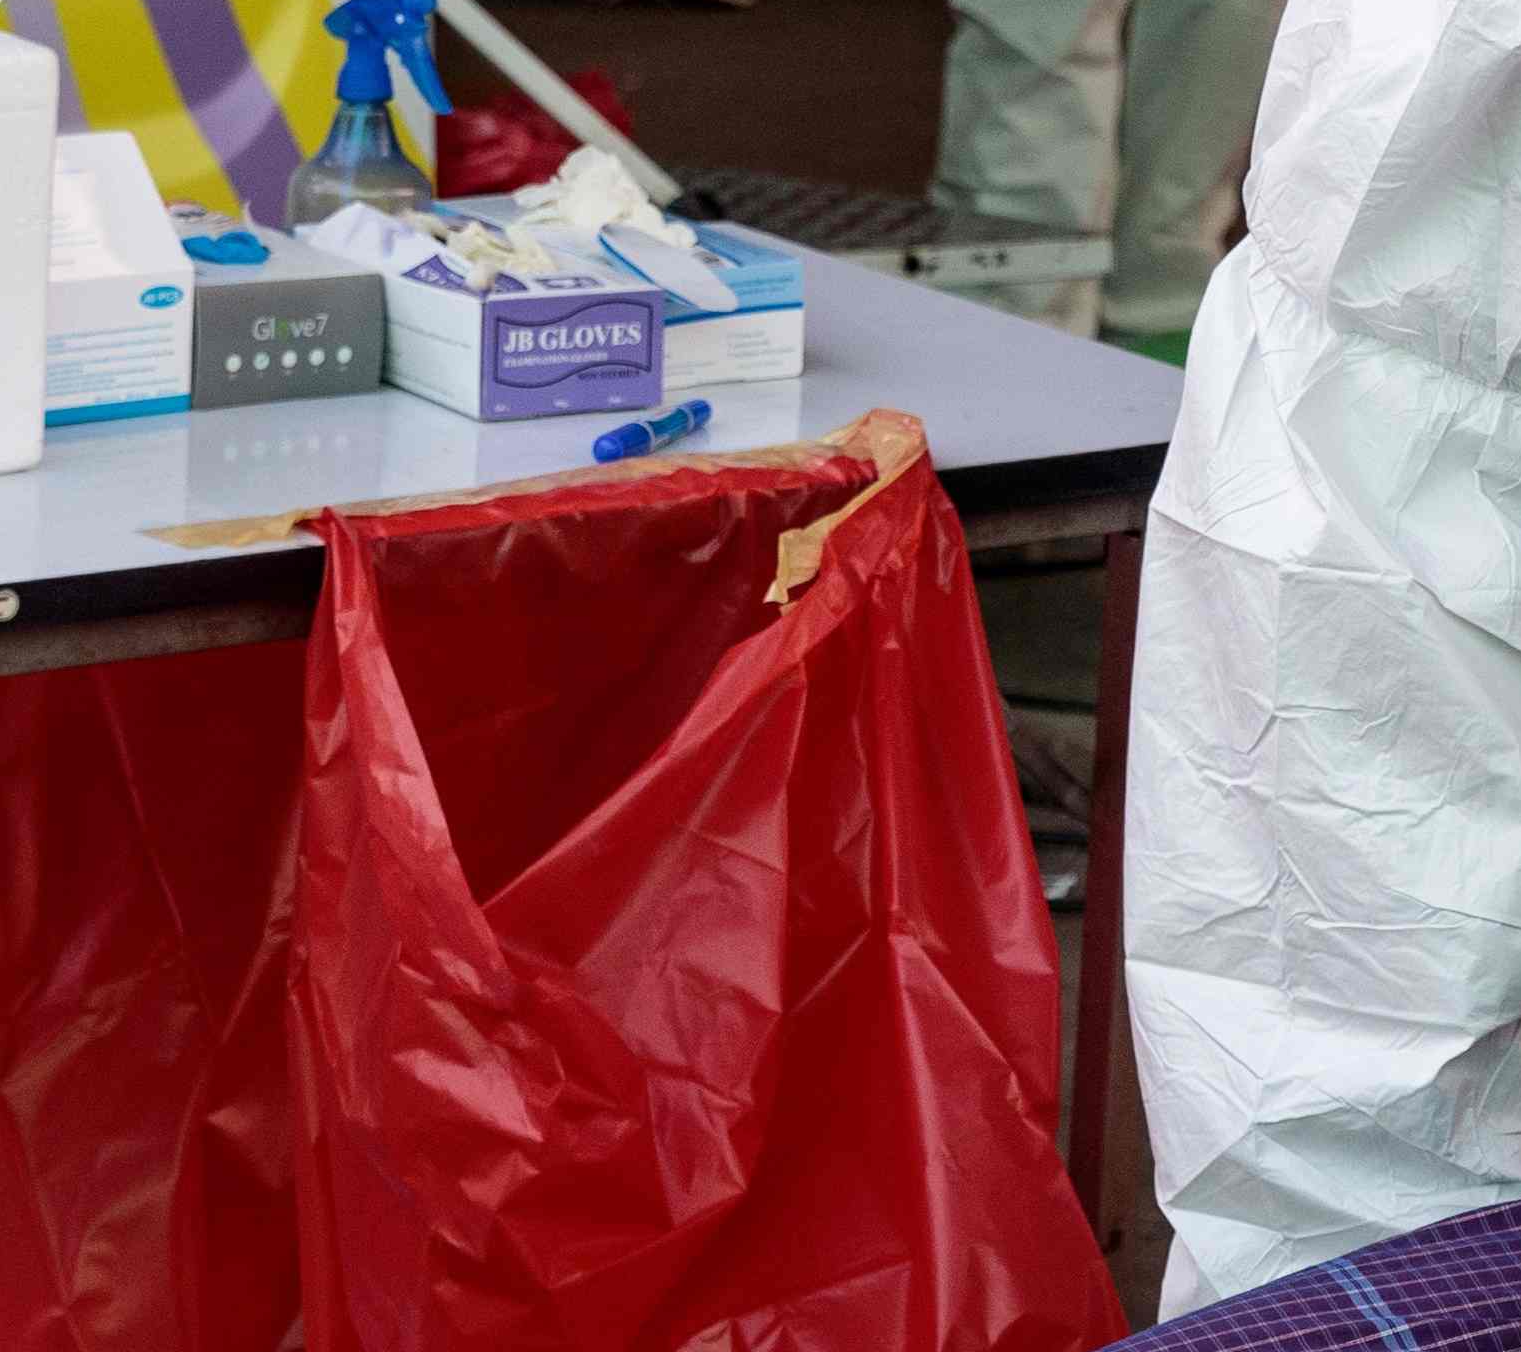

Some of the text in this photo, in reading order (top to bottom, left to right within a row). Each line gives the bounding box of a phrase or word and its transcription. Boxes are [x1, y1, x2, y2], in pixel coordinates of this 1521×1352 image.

[252, 312, 330, 342] Glove7
[503, 321, 642, 353] JB GLOVES
